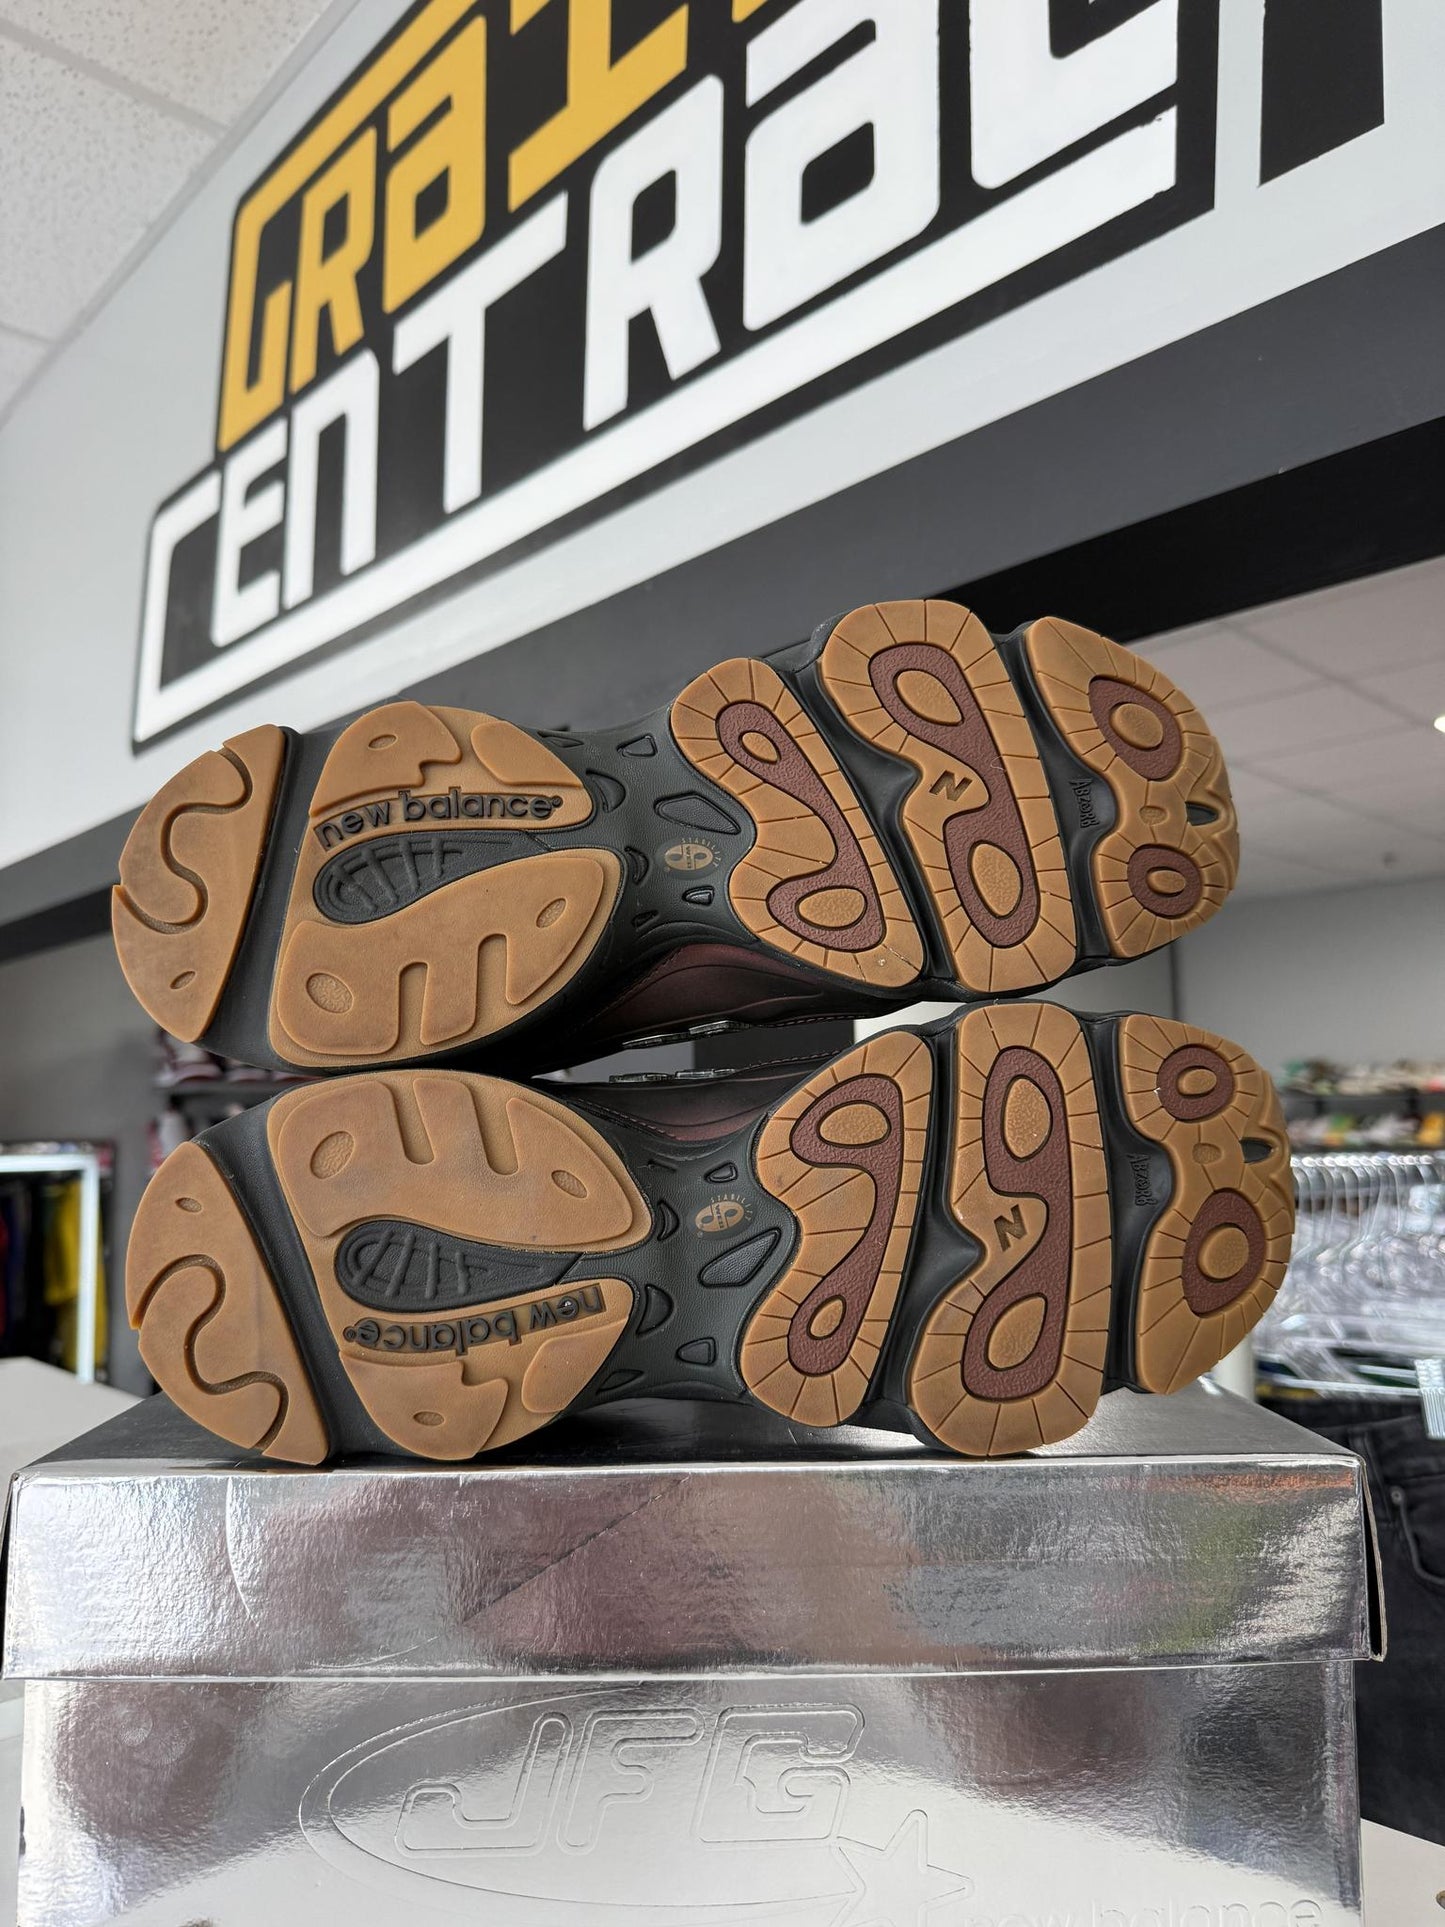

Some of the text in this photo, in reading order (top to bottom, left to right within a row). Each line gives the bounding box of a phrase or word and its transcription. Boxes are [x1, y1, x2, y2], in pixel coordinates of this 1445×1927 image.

[314, 801, 391, 850] new
[529, 1285, 603, 1331] new
[394, 1702, 866, 1858] JFG
